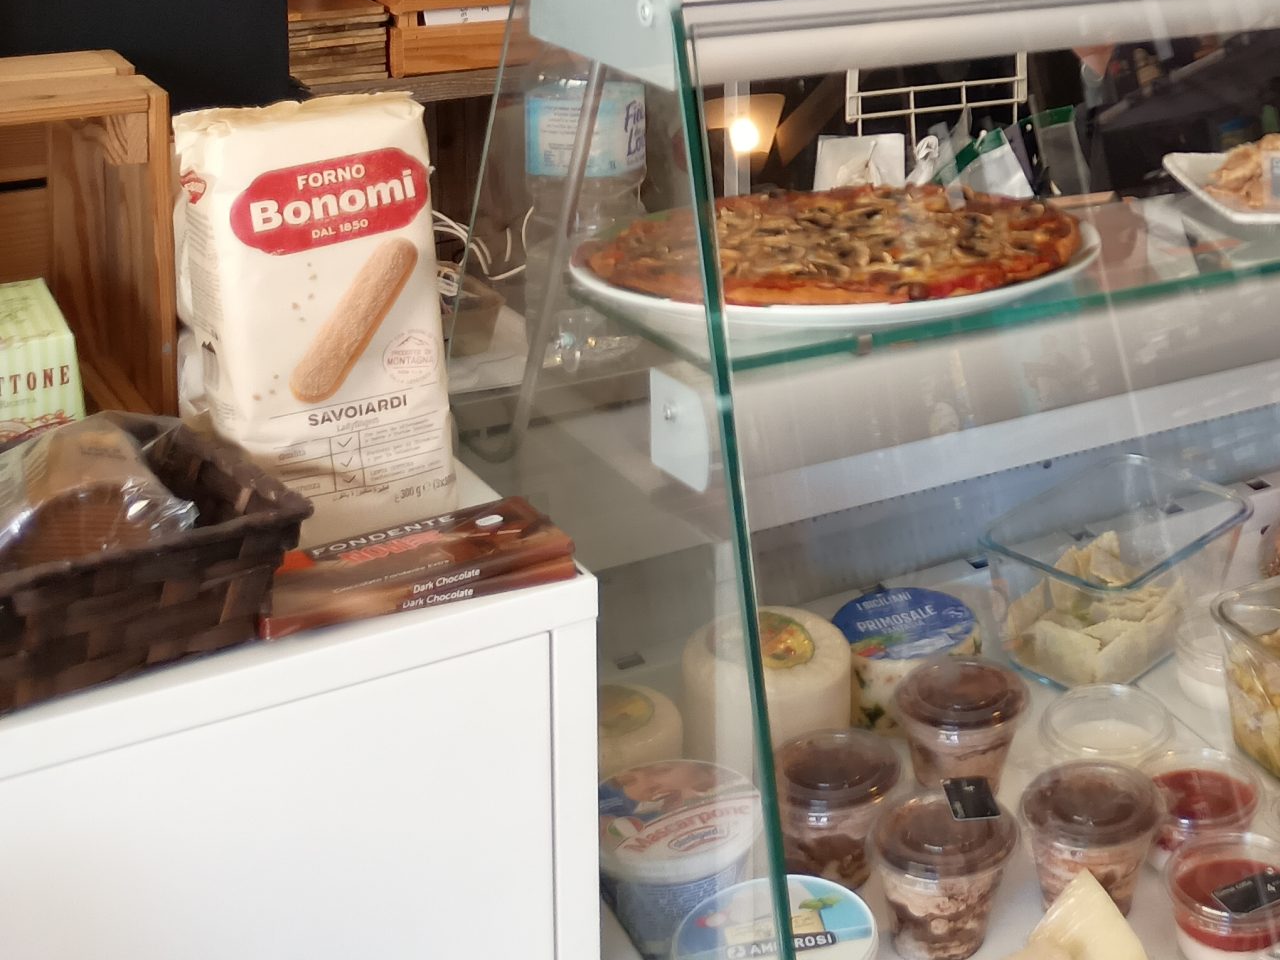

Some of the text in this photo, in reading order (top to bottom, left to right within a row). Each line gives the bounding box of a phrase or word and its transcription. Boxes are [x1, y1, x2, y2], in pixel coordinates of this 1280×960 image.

[296, 163, 367, 191] FORNO
[250, 170, 417, 233] Bonomi
[311, 218, 369, 239] DAL 1850
[308, 394, 408, 427] SAVOIARDI
[311, 514, 456, 557] FONDENTE
[413, 566, 481, 594] Dark Chocolate
[402, 586, 474, 610] Dark Chocolate
[856, 604, 938, 633] PRIMOSALE
[623, 804, 751, 853] Mascarpone
[750, 933, 833, 956] AMROSI
